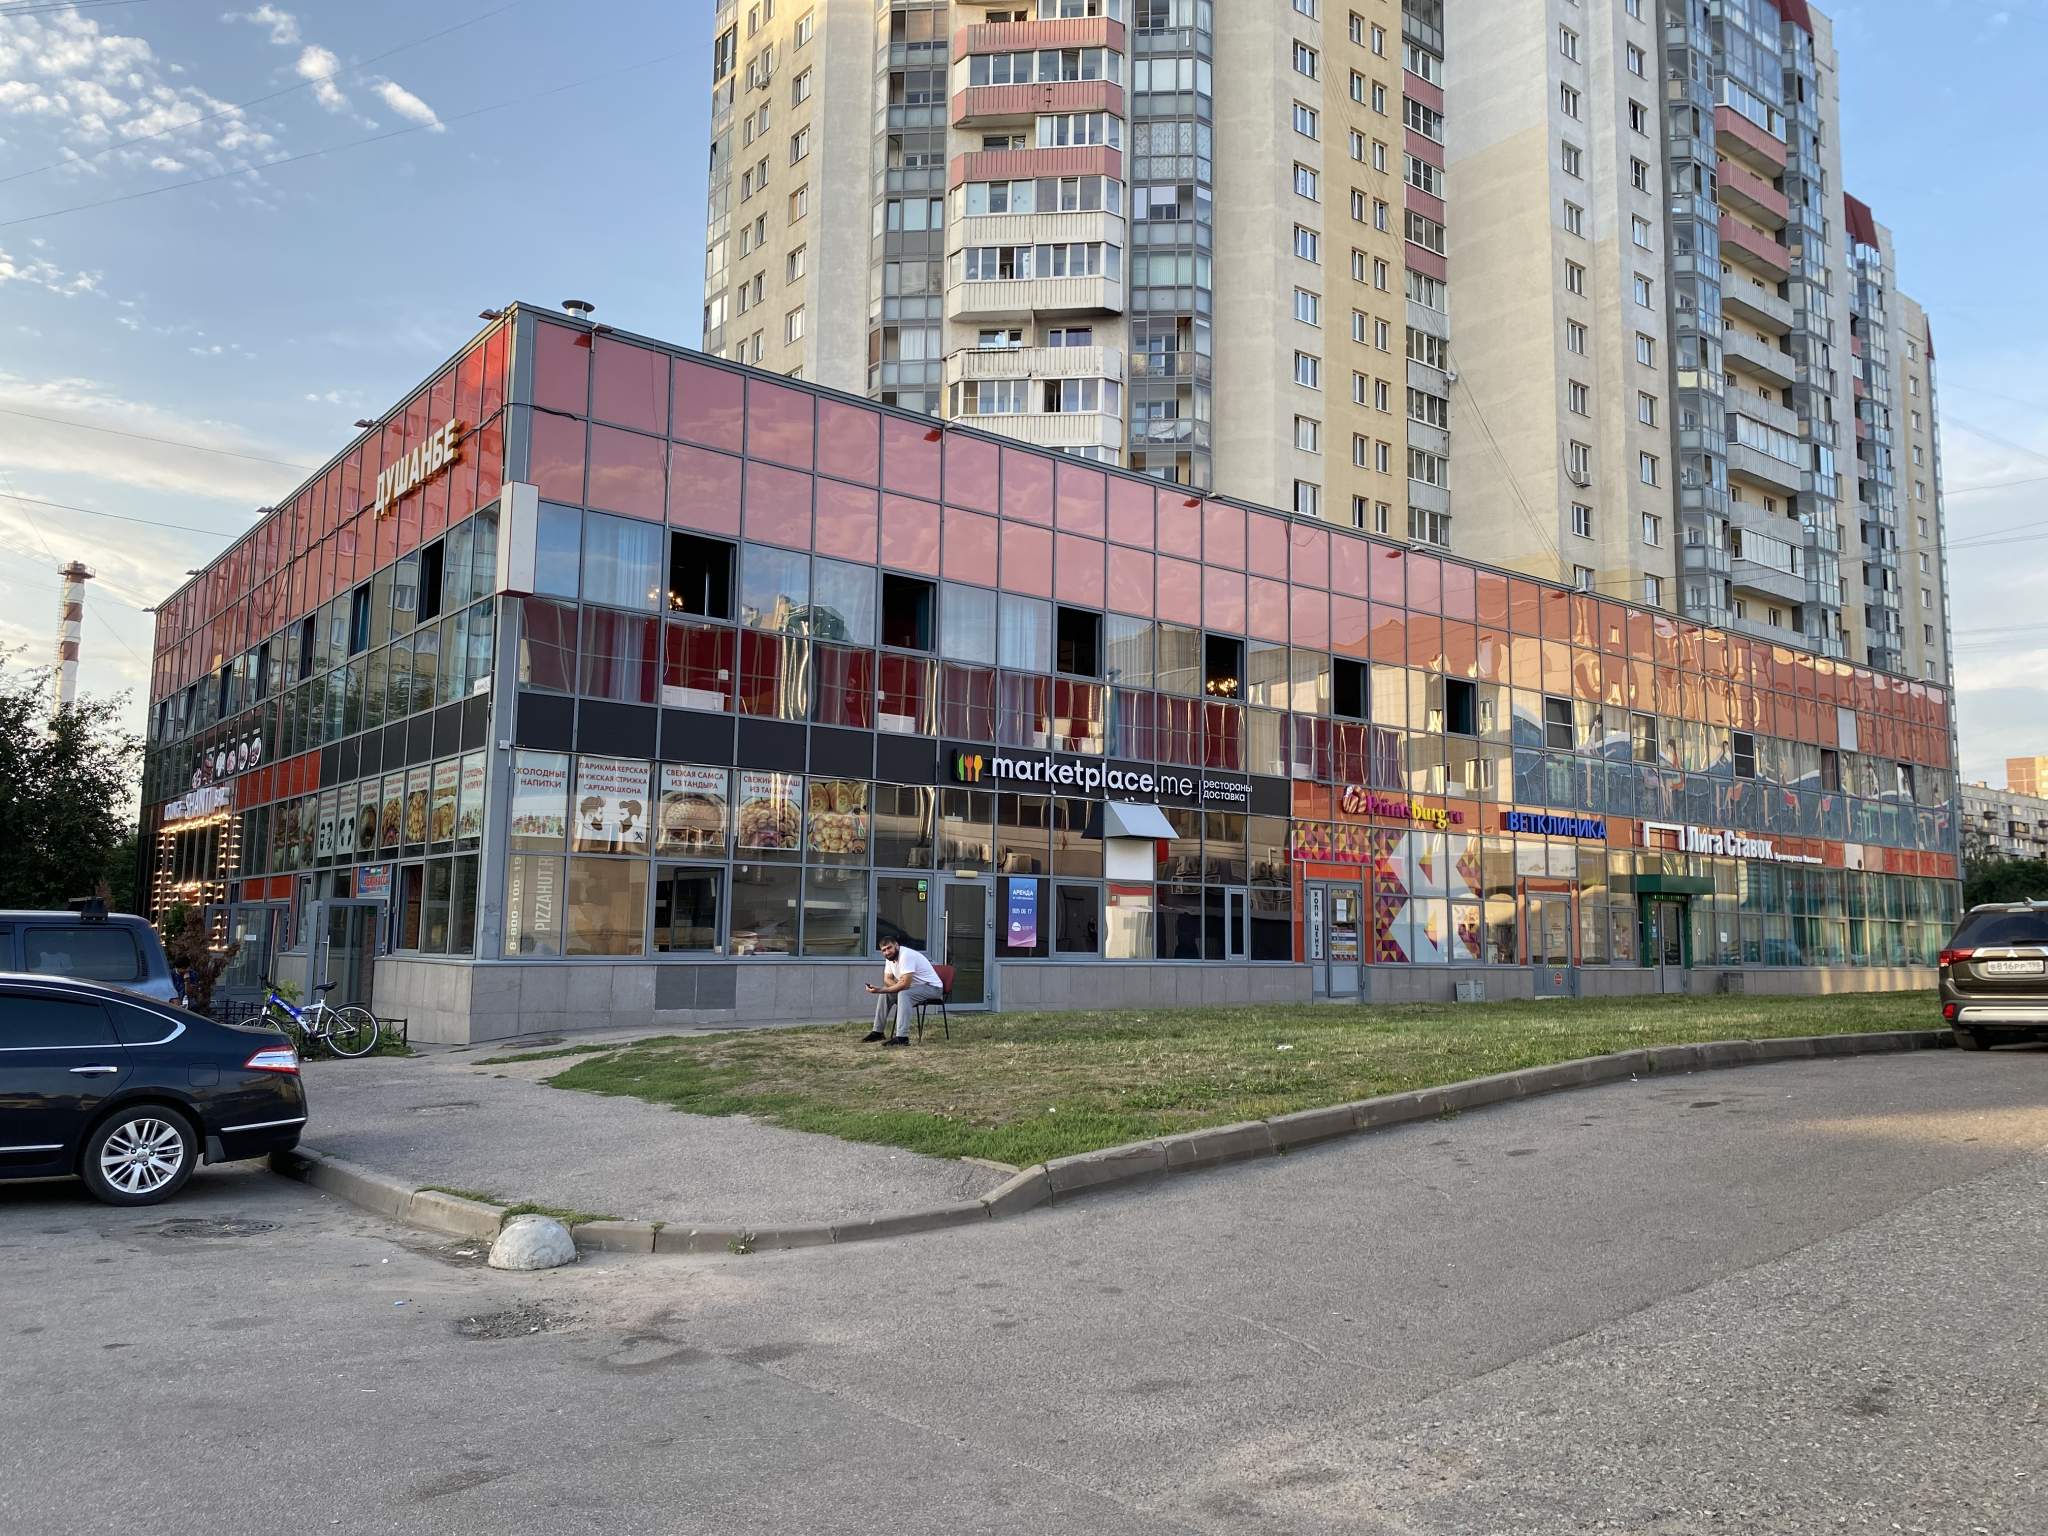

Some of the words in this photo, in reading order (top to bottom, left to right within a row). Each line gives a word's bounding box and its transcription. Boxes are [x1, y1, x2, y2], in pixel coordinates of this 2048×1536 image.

[374, 418, 459, 520] ДУШАНБЕ
[515, 767, 567, 779] ХОЛОДНЫЕ
[579, 762, 648, 774] ПАРИКМАХЕРСКАЯ
[666, 768, 696, 778] СВЕЖАЯ
[697, 771, 724, 780] САМСА
[578, 773, 614, 782] МУЖСКАЯ
[615, 776, 648, 785] СТРИЖКА
[992, 756, 1193, 796] marketplace.me
[520, 779, 561, 789] НАПИТКИ
[671, 779, 681, 787] ИЗ
[683, 780, 719, 790] ТАНДЫРА
[1203, 779, 1253, 793] рестораны
[1203, 790, 1246, 802] доставка
[1509, 811, 1607, 839] ВЕТКЛИНИКА
[1686, 825, 1724, 855] Лига
[1724, 830, 1774, 860] Ставок
[1012, 888, 1034, 897] АРЕНДА
